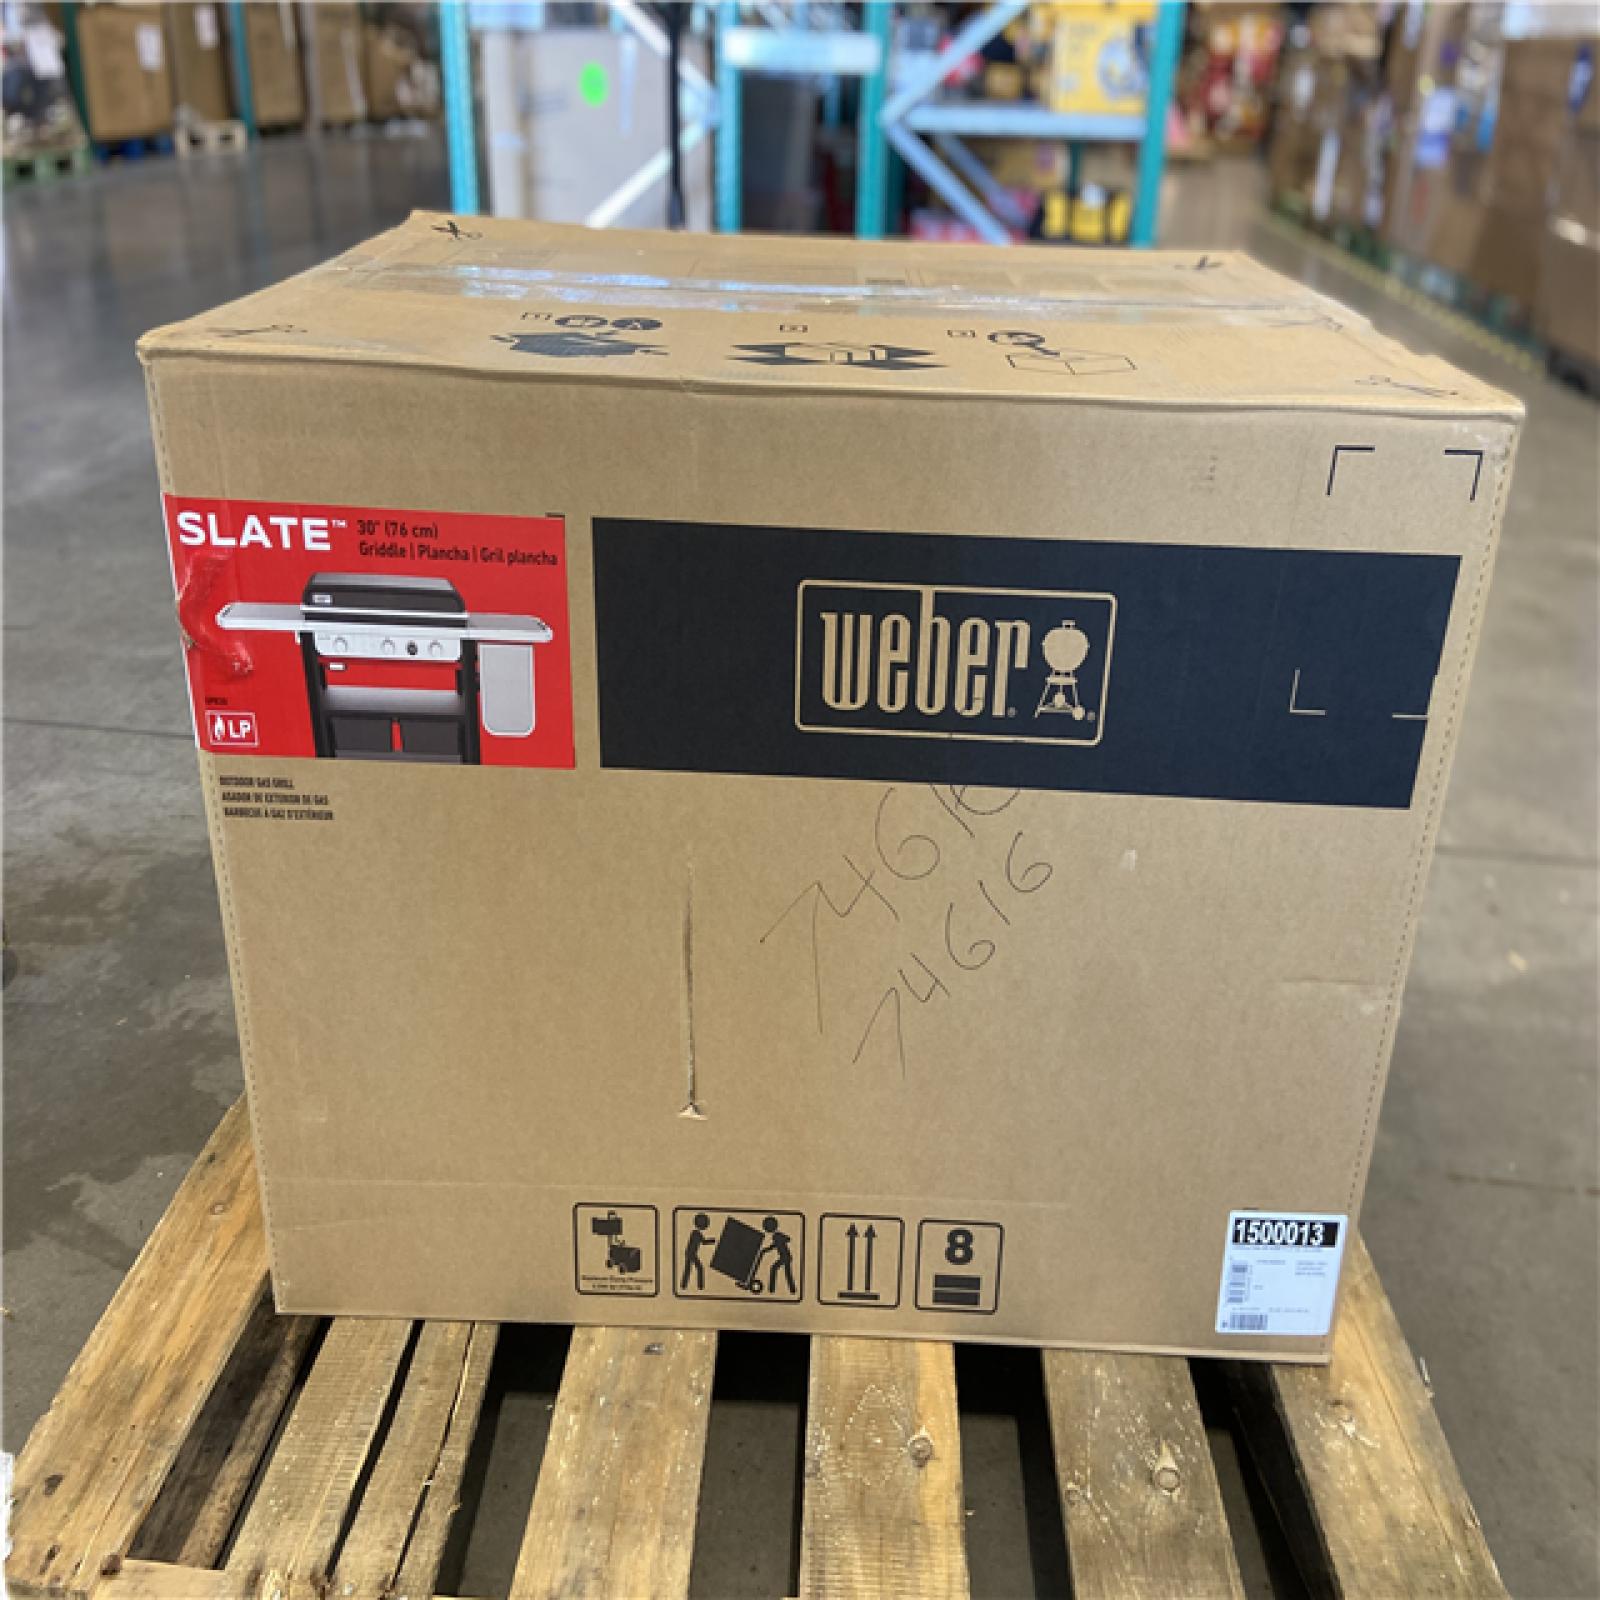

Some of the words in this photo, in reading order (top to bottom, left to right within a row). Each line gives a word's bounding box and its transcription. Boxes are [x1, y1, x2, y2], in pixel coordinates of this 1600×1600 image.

[384, 520, 408, 537] (76
[412, 523, 439, 540] cm)
[359, 540, 406, 558] Griddle
[418, 545, 471, 561] Plancha
[480, 547, 505, 563] Gril
[507, 550, 559, 567] plancha
[819, 585, 1031, 716] weber
[228, 719, 251, 739] LP
[851, 830, 1054, 1081] 74616
[943, 1227, 975, 1265] 8
[1235, 1220, 1324, 1246] 1500013
